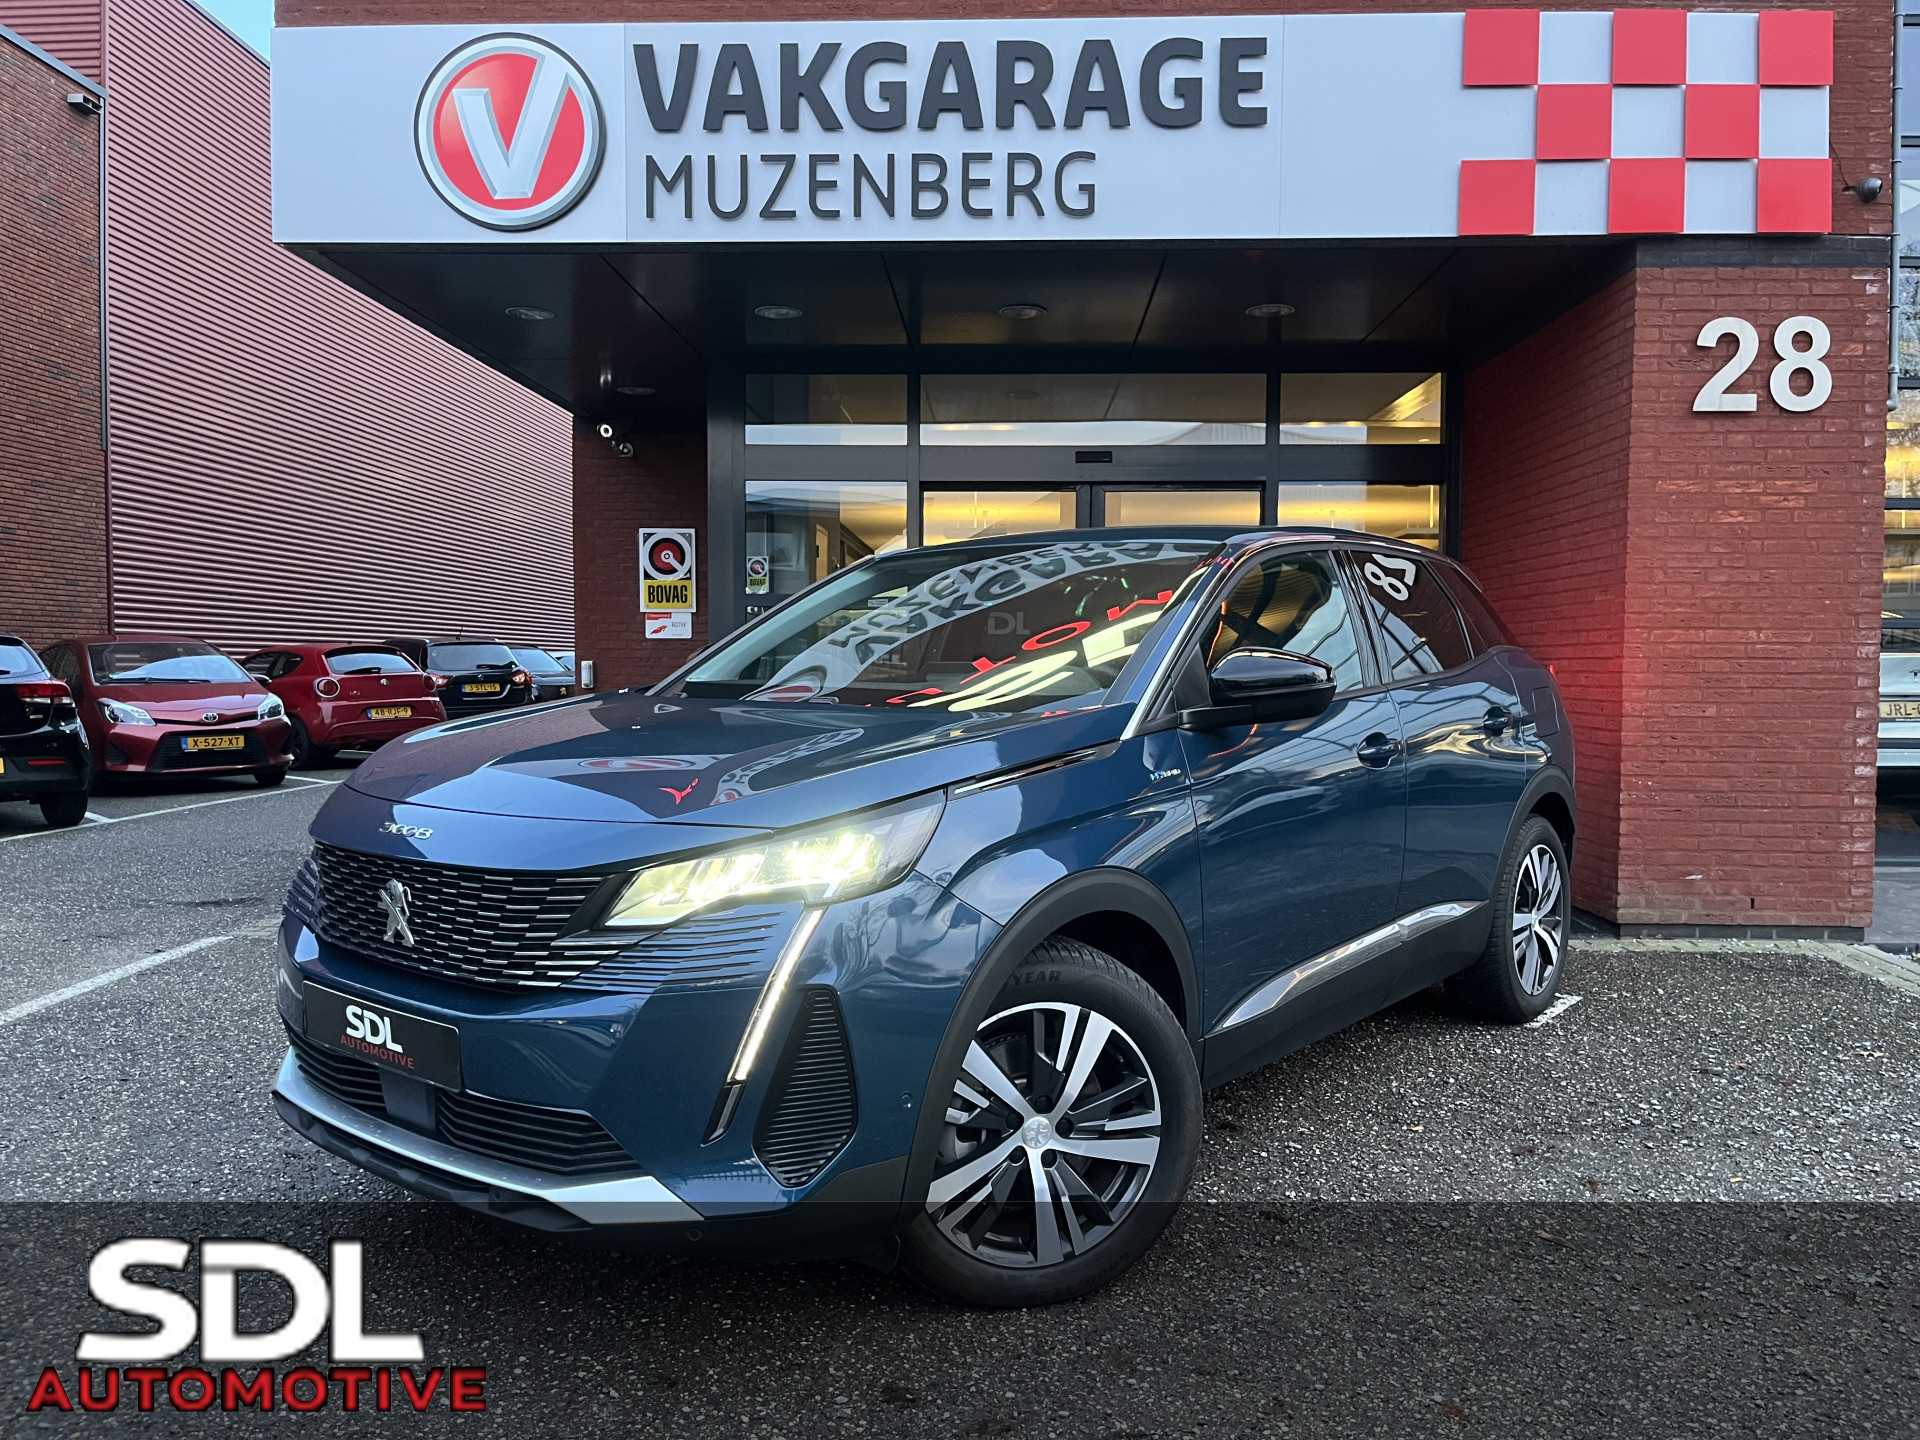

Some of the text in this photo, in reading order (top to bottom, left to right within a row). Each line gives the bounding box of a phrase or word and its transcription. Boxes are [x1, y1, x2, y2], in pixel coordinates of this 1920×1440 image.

[632, 36, 1269, 133] VAKGARAGE
[644, 150, 1097, 220] MUZENBERG
[1692, 315, 1833, 412] 28
[647, 584, 688, 604] BOVAG
[984, 611, 1031, 635] DL
[192, 736, 240, 748] X-527-XT
[345, 1004, 404, 1053] SDL
[340, 1034, 415, 1070] AUTOMOTIVE
